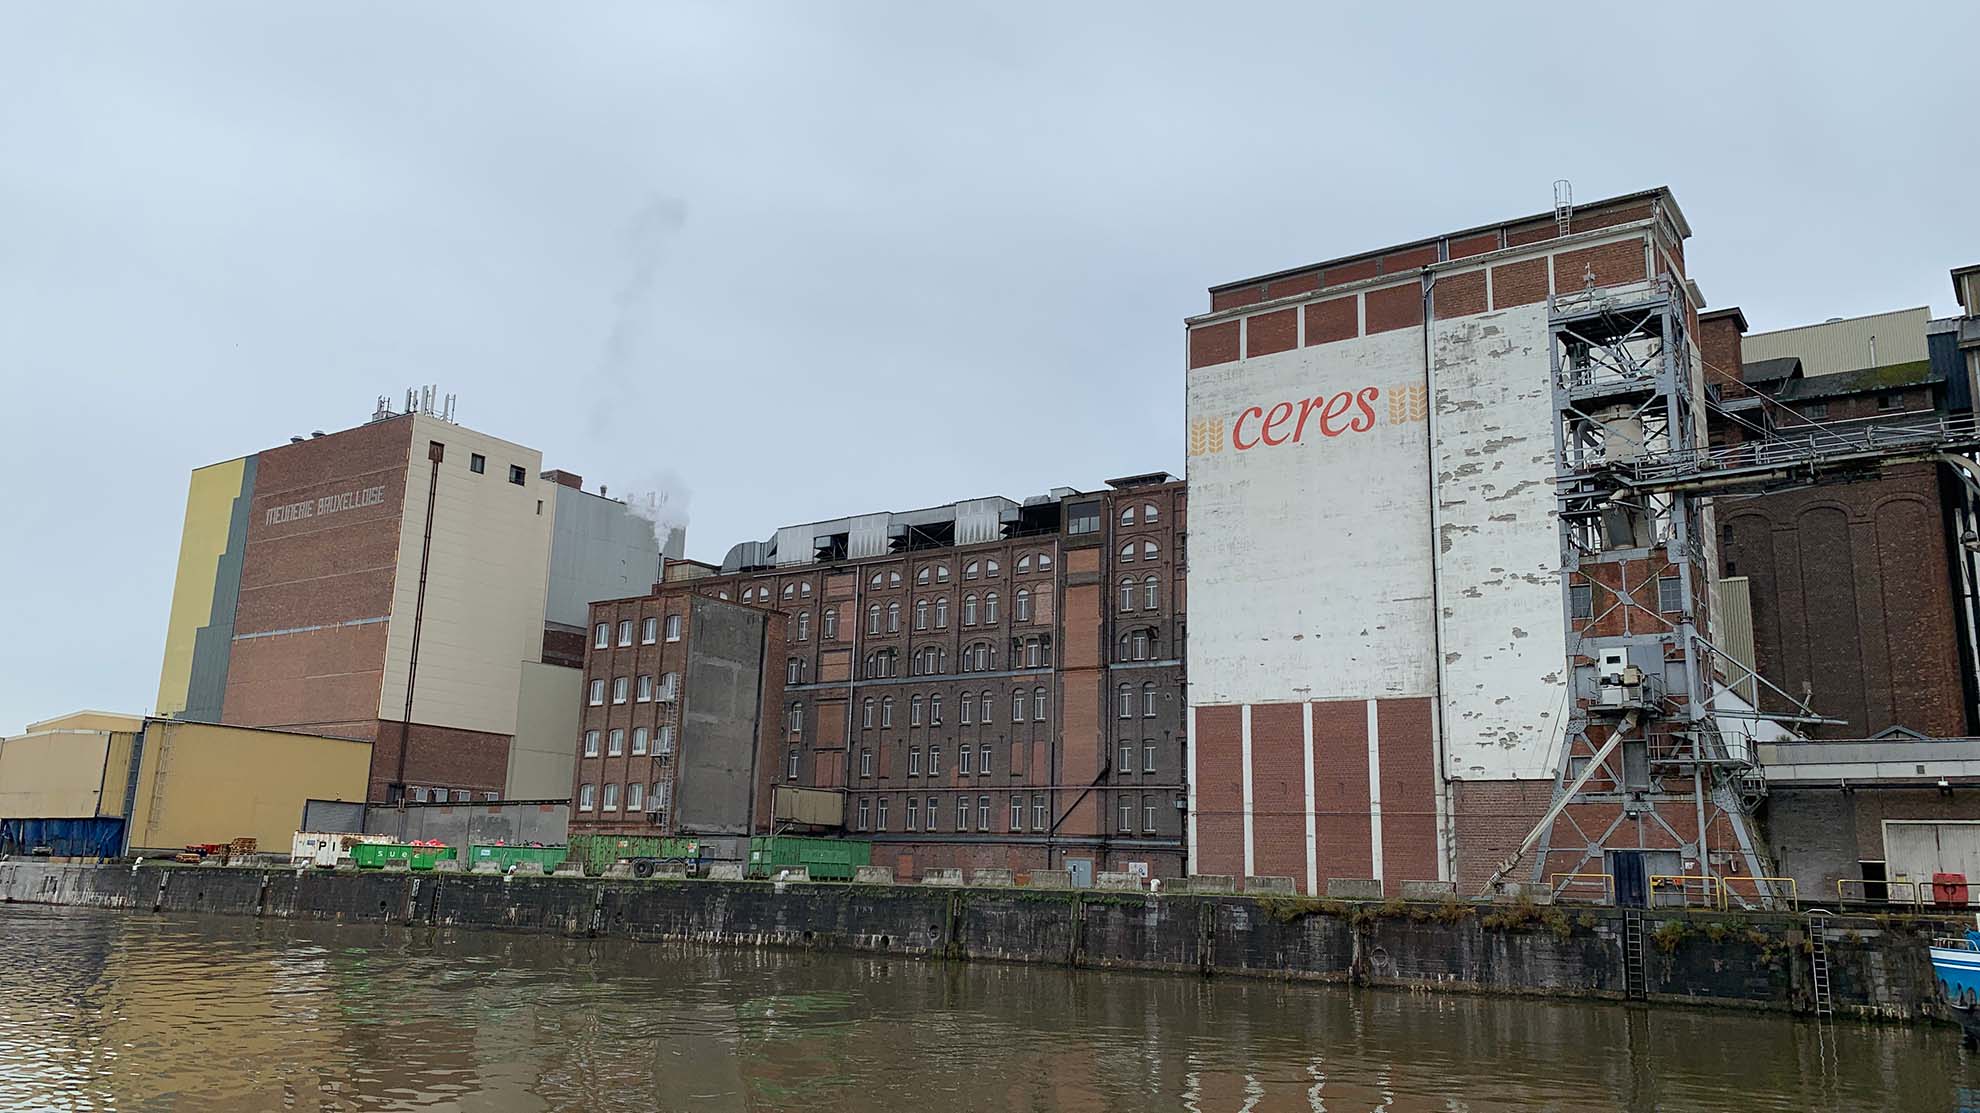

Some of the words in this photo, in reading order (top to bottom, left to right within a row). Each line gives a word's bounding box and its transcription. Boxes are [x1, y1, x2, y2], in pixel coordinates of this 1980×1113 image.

[1233, 386, 1380, 451] ceres
[265, 499, 315, 526] MEUNERIE
[317, 485, 386, 515] BRUXELLOISE
